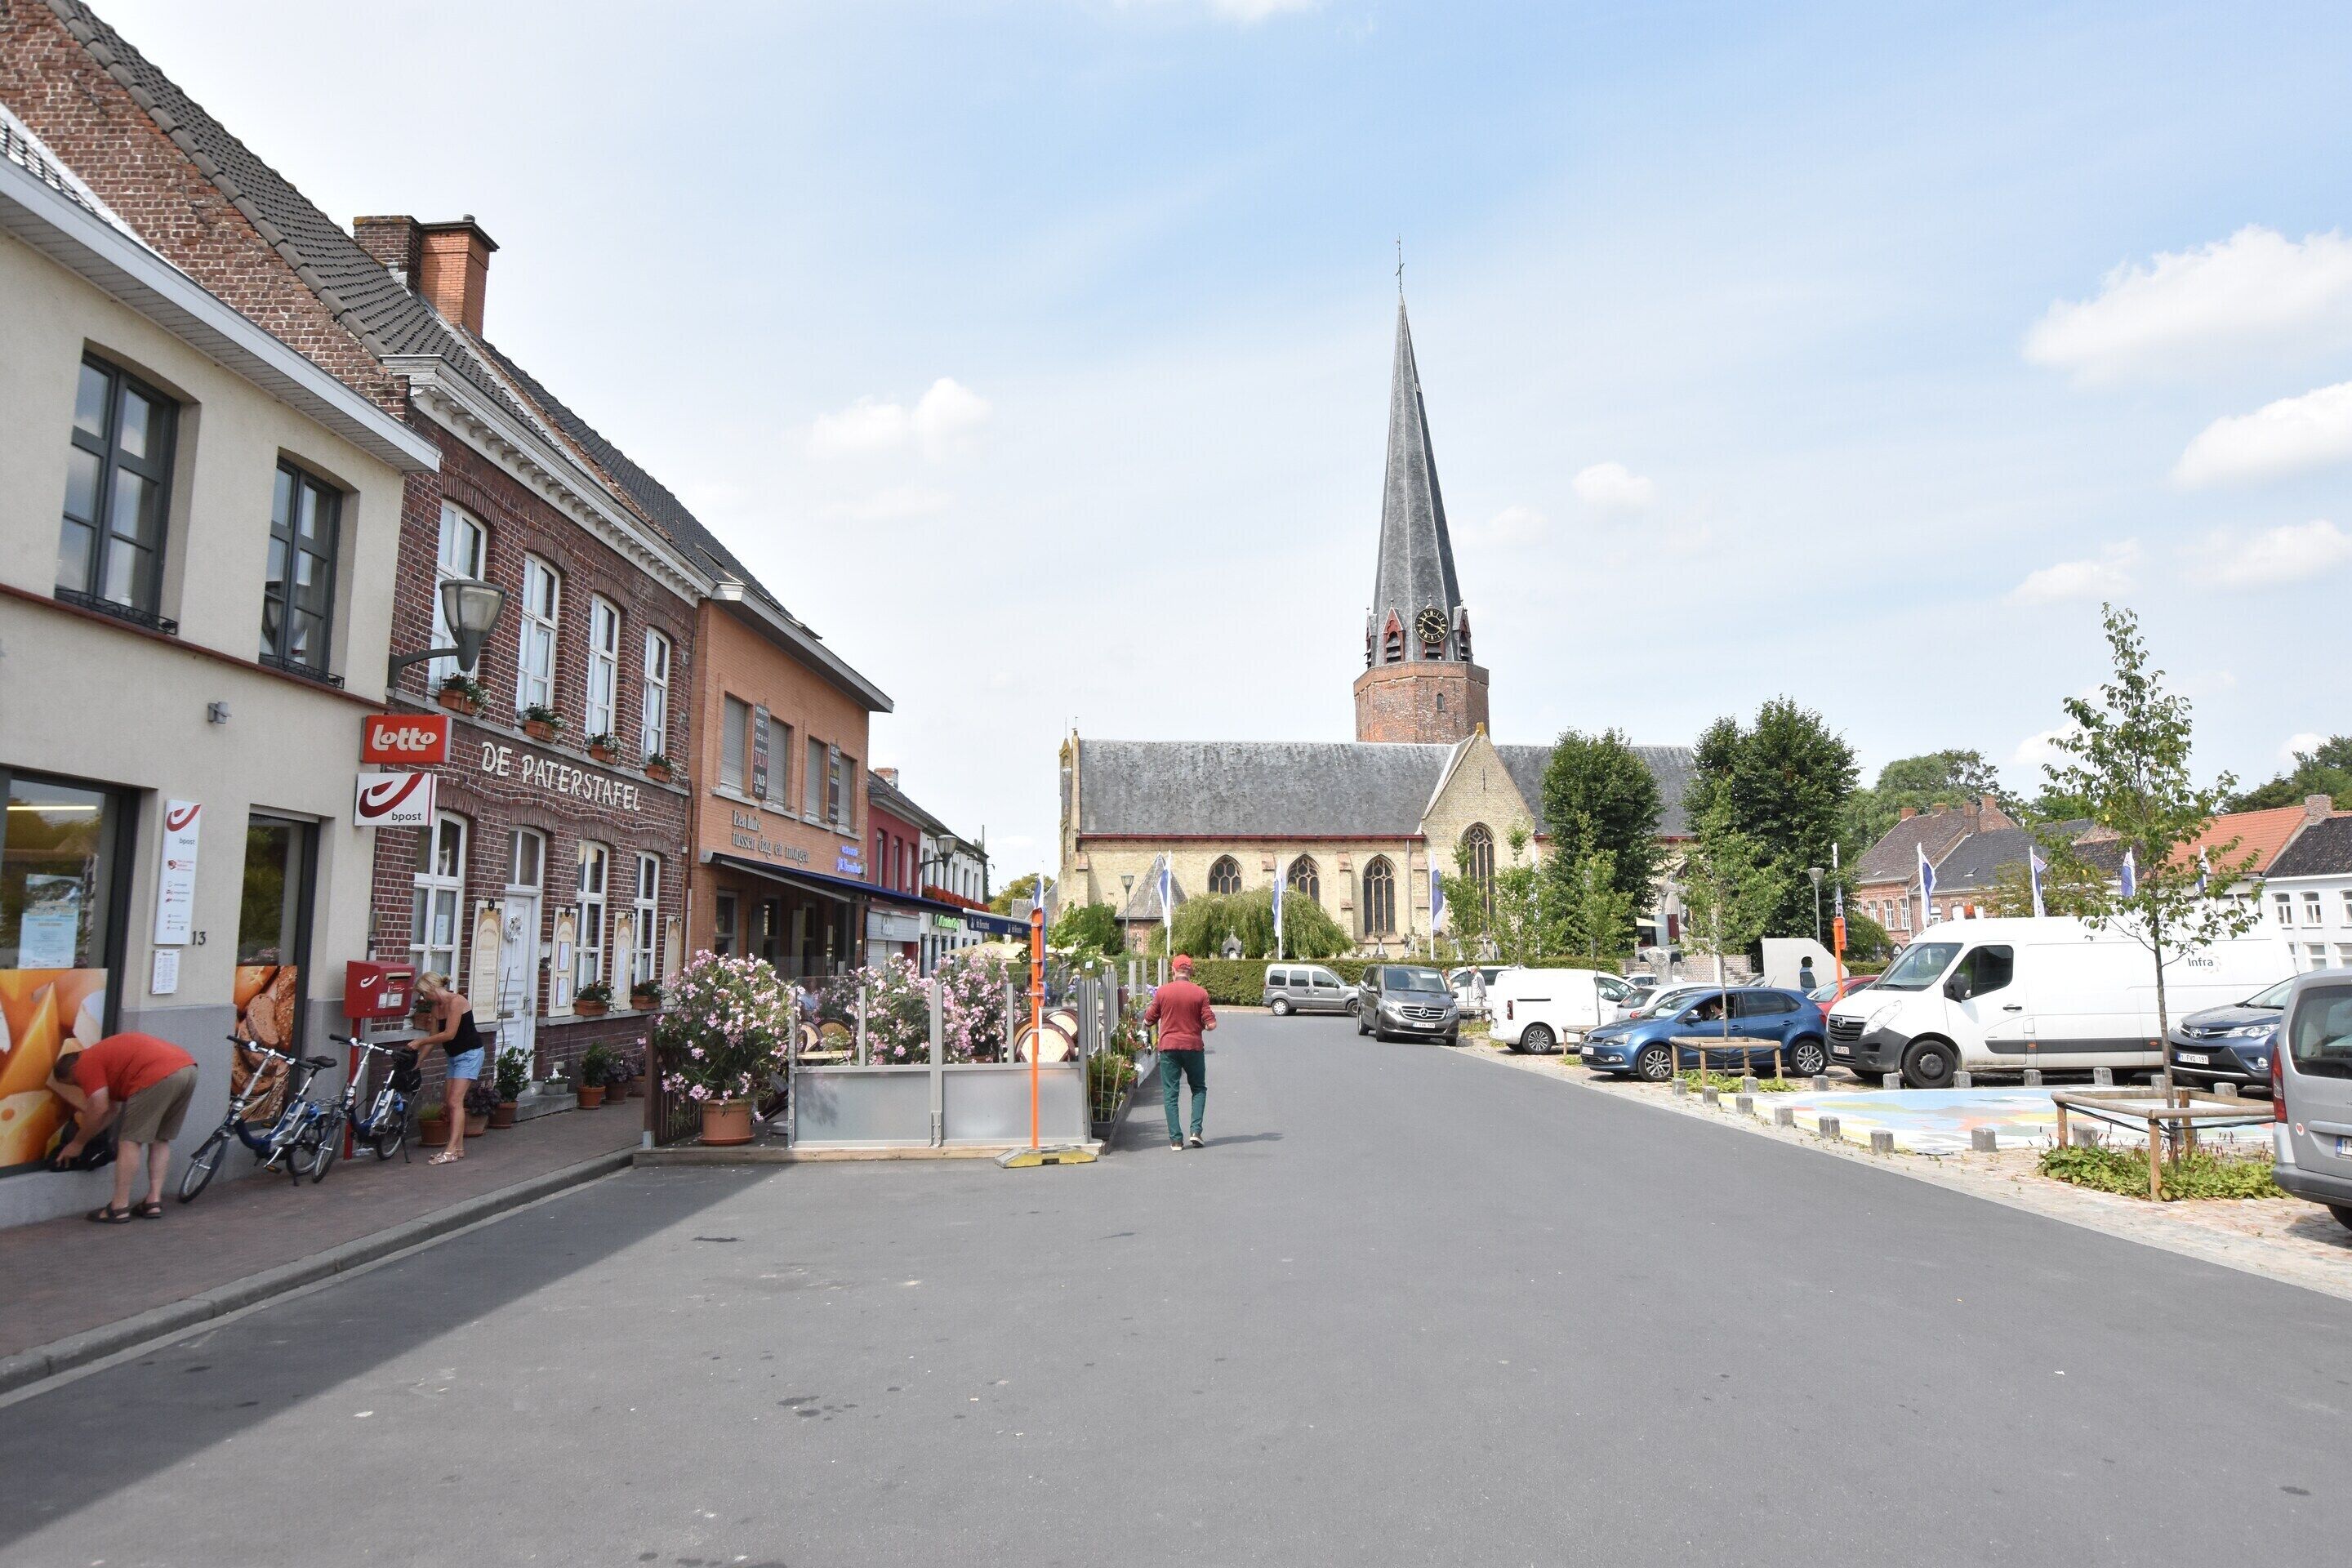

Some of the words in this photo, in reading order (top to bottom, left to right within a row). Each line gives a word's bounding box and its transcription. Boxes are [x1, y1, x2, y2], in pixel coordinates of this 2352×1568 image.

[482, 742, 513, 777] DE
[521, 755, 641, 812] PATERSTAFEL
[391, 812, 422, 822] bpost
[178, 836, 196, 846] bpost
[759, 835, 772, 858] dag
[774, 843, 784, 856] en
[786, 846, 810, 866] morgen
[191, 930, 207, 946] 13
[2187, 957, 2214, 967] Infra
